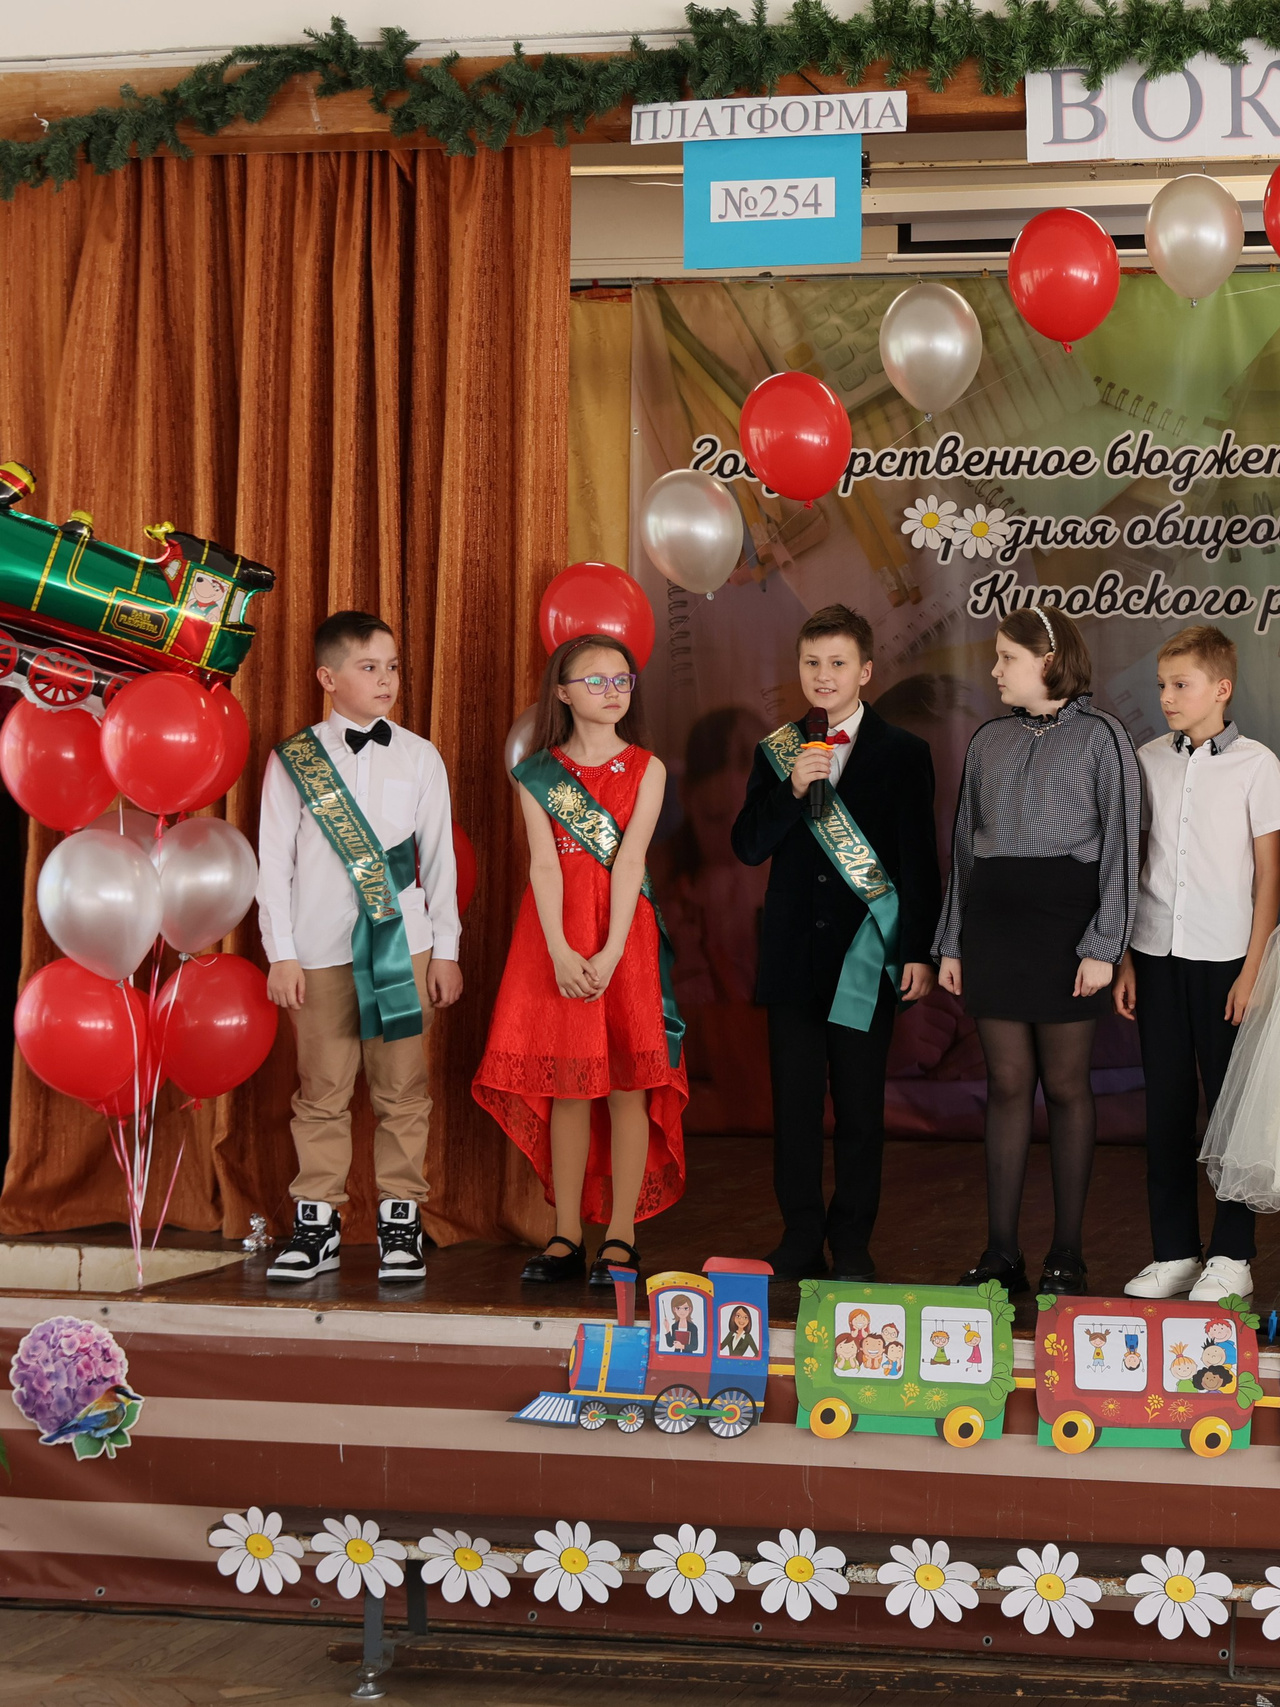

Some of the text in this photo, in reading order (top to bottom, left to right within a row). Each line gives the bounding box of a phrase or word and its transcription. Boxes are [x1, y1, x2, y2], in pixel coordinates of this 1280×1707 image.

[632, 93, 906, 143] ПЛАТФОРМА
[717, 180, 824, 221] №254
[693, 435, 1096, 494] Горственное
[350, 860, 396, 920] 2024
[833, 842, 891, 900] 2024
